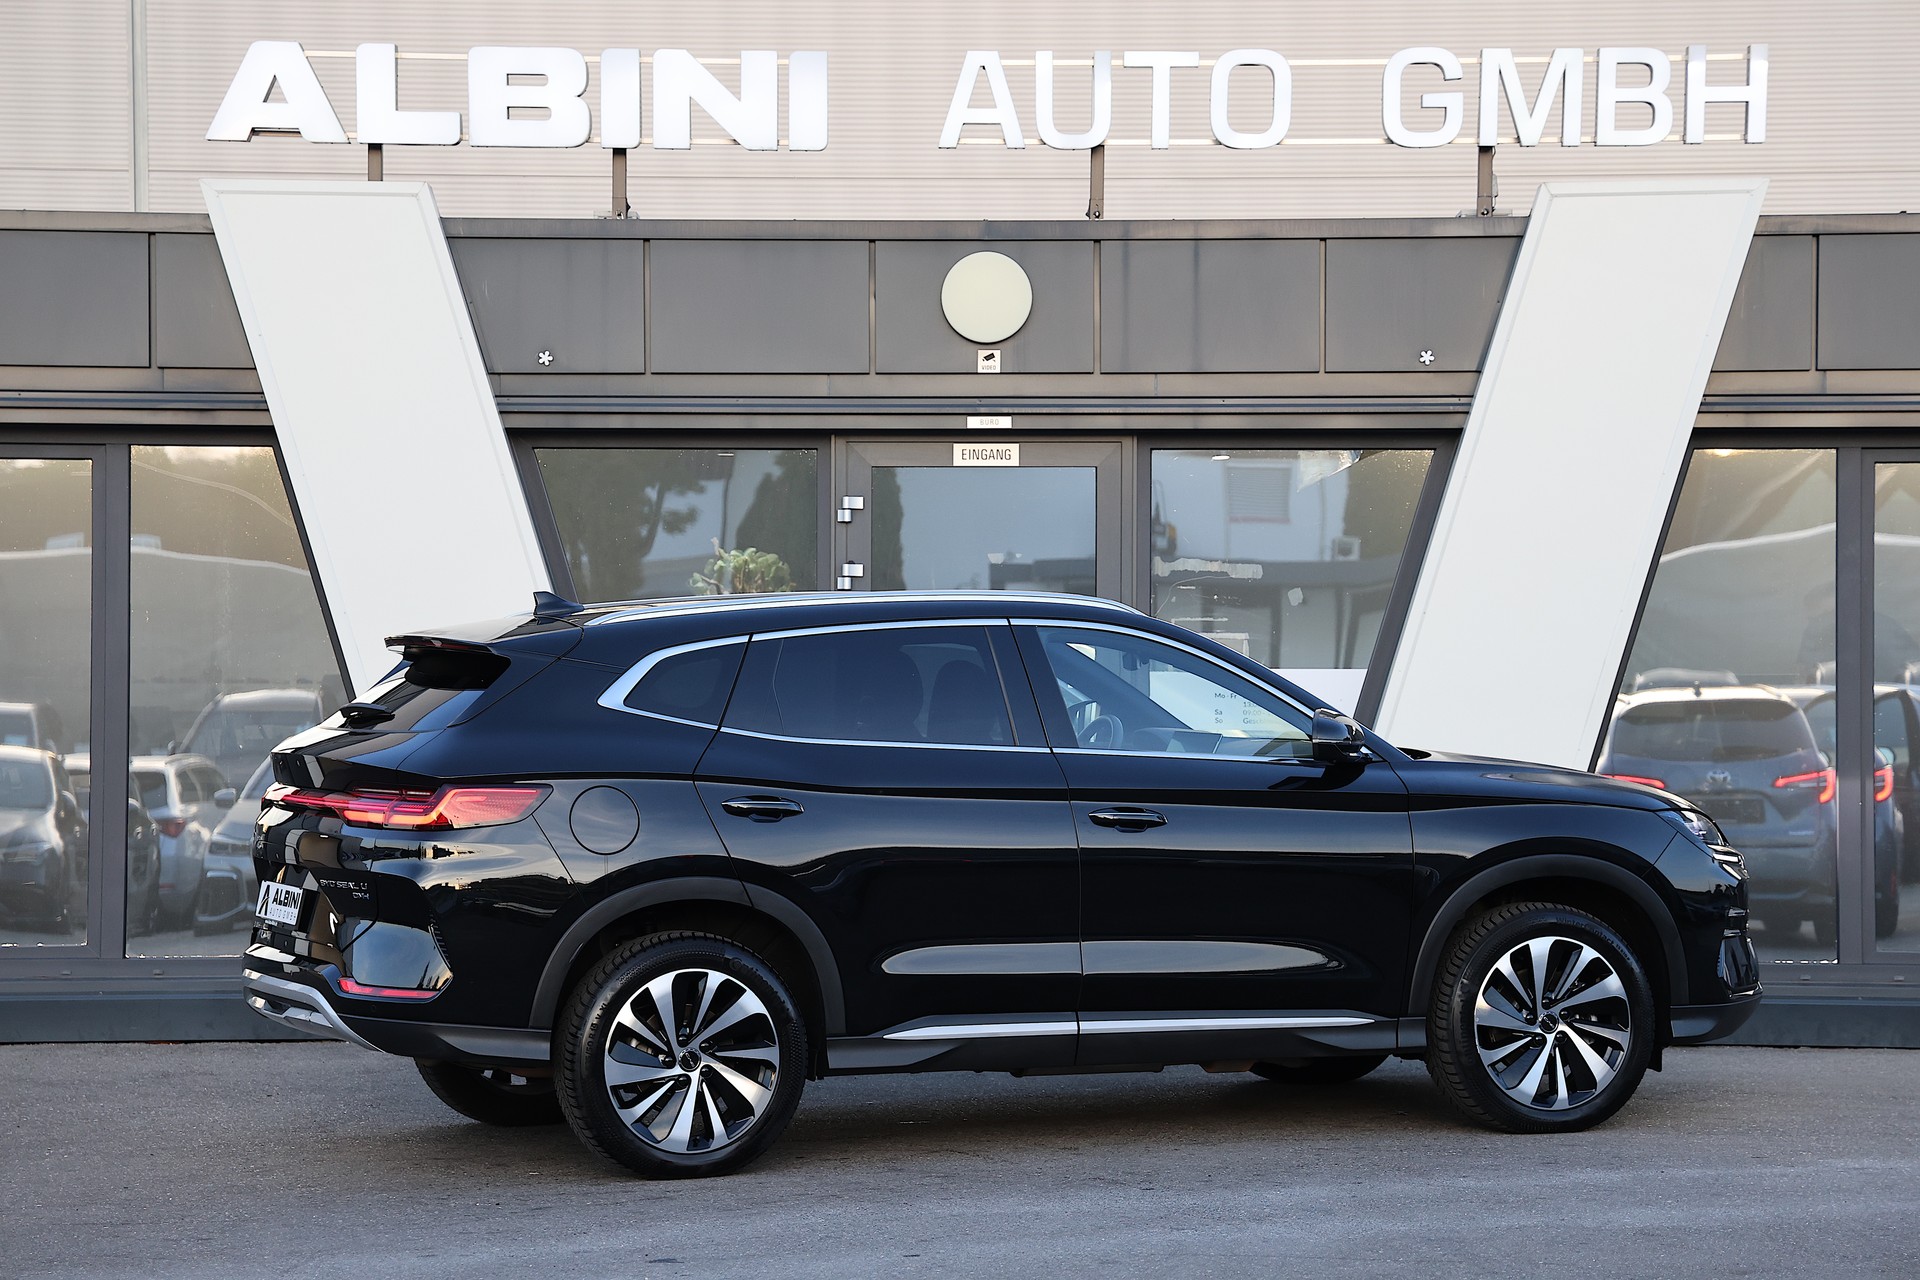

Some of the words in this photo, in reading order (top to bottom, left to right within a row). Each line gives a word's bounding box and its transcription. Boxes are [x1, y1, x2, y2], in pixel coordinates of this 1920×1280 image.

[205, 40, 829, 152] ALBINI
[938, 48, 1293, 150] AUTO
[1381, 43, 1769, 148] GMBH
[961, 448, 1012, 461] EINGANG
[272, 888, 301, 909] ALBINI
[269, 907, 282, 918] AUTO
